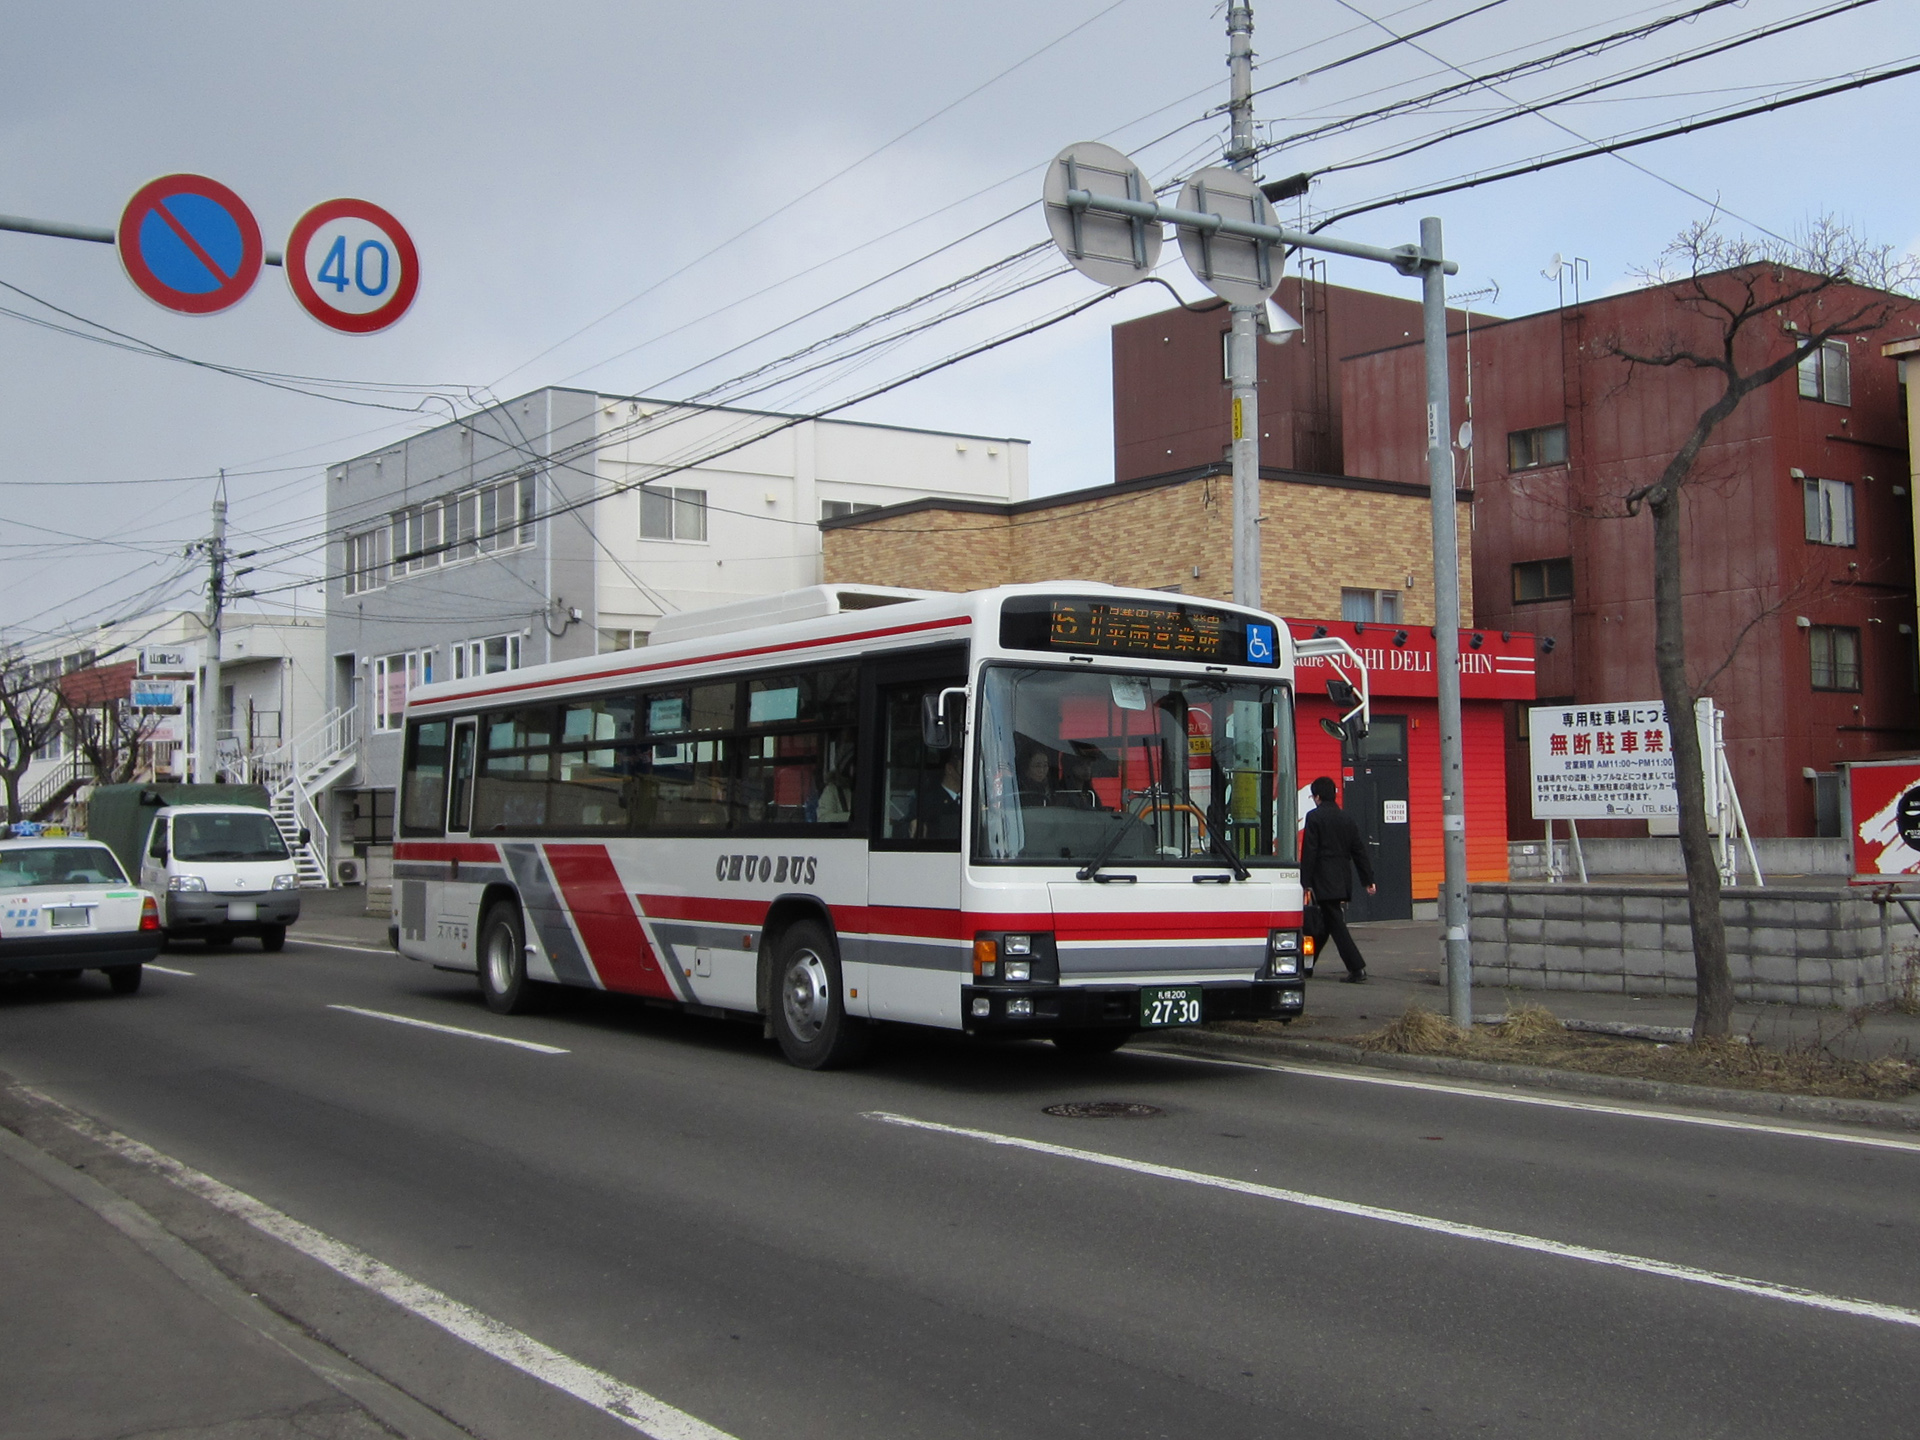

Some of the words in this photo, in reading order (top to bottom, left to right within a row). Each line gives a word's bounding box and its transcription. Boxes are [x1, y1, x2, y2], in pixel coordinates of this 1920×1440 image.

[317, 235, 389, 297] 40
[1293, 656, 1324, 668] ature
[1330, 648, 1384, 670] SUSHI
[1390, 650, 1431, 672] DELI
[1550, 729, 1674, 756] 無断駐車禁
[1564, 760, 1595, 770] 営業時間
[716, 855, 771, 882] CHUO
[773, 856, 818, 885] BUS
[1151, 1000, 1199, 1023] 27-30
